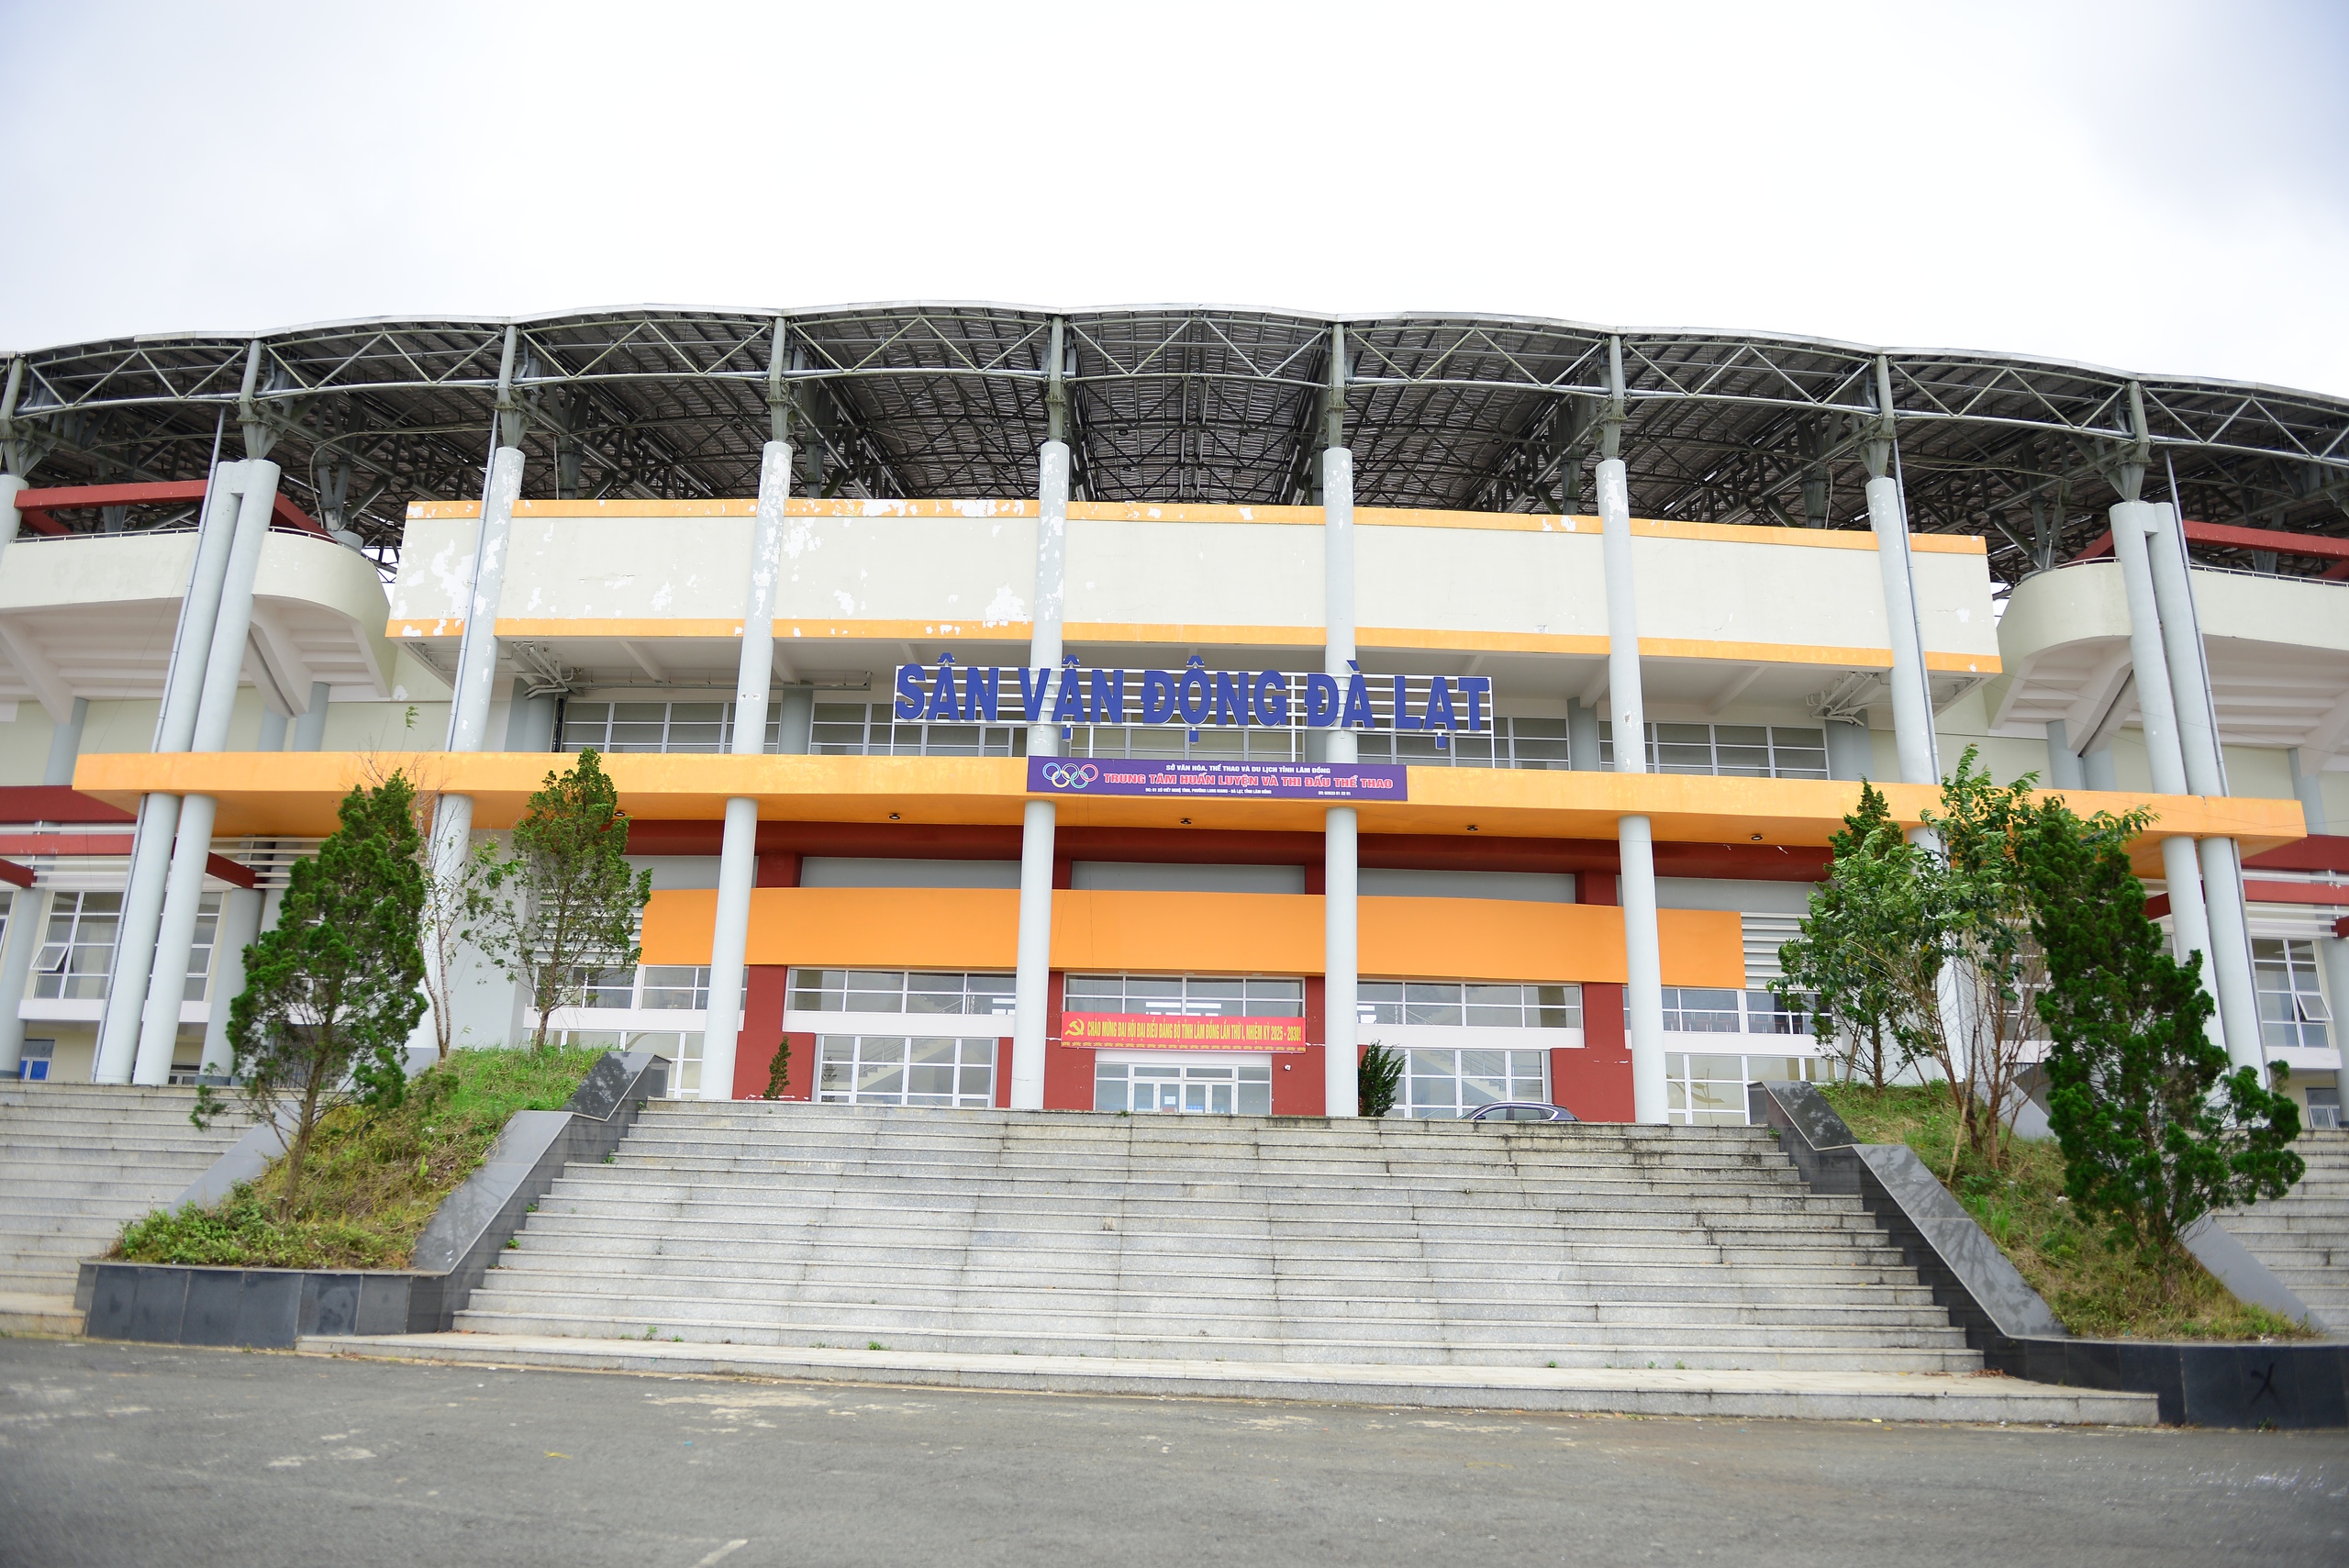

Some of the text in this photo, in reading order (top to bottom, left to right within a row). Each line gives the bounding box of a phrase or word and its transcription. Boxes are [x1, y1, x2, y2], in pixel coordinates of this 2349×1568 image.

[895, 652, 1491, 749] SÂN VẬN ĐỘNG ĐÀ LẠT
[1176, 763, 1190, 772] VĂN
[1209, 763, 1222, 772] THỂ
[1241, 764, 1251, 773] VÀ
[1279, 765, 1295, 773] TỈNH
[1104, 773, 1394, 789] TRUNG TÂM HUẤN LUYỆN VÀ THI ĐẤU THỂ THAO
[1087, 1018, 1101, 1037] CHÀO
[1101, 1018, 1118, 1037] MỪNG
[1118, 1022, 1127, 1041] ĐẠI
[1128, 1018, 1136, 1041] HỘI
[1137, 1022, 1146, 1041] ĐẠI
[1146, 1017, 1158, 1038] BIỂU
[1159, 1018, 1174, 1039] ĐẢNG
[1174, 1020, 1181, 1042] BỘ
[1182, 1018, 1194, 1040] TỈNH
[1194, 1020, 1205, 1040] LÂM
[1206, 1018, 1219, 1040] ĐỒNG
[1220, 1018, 1230, 1040] LẦN
[1231, 1021, 1241, 1040] THỨ
[1246, 1021, 1263, 1043] NHIỆM
[1264, 1021, 1271, 1040] KỲ
[1271, 1025, 1284, 1041] 2025
